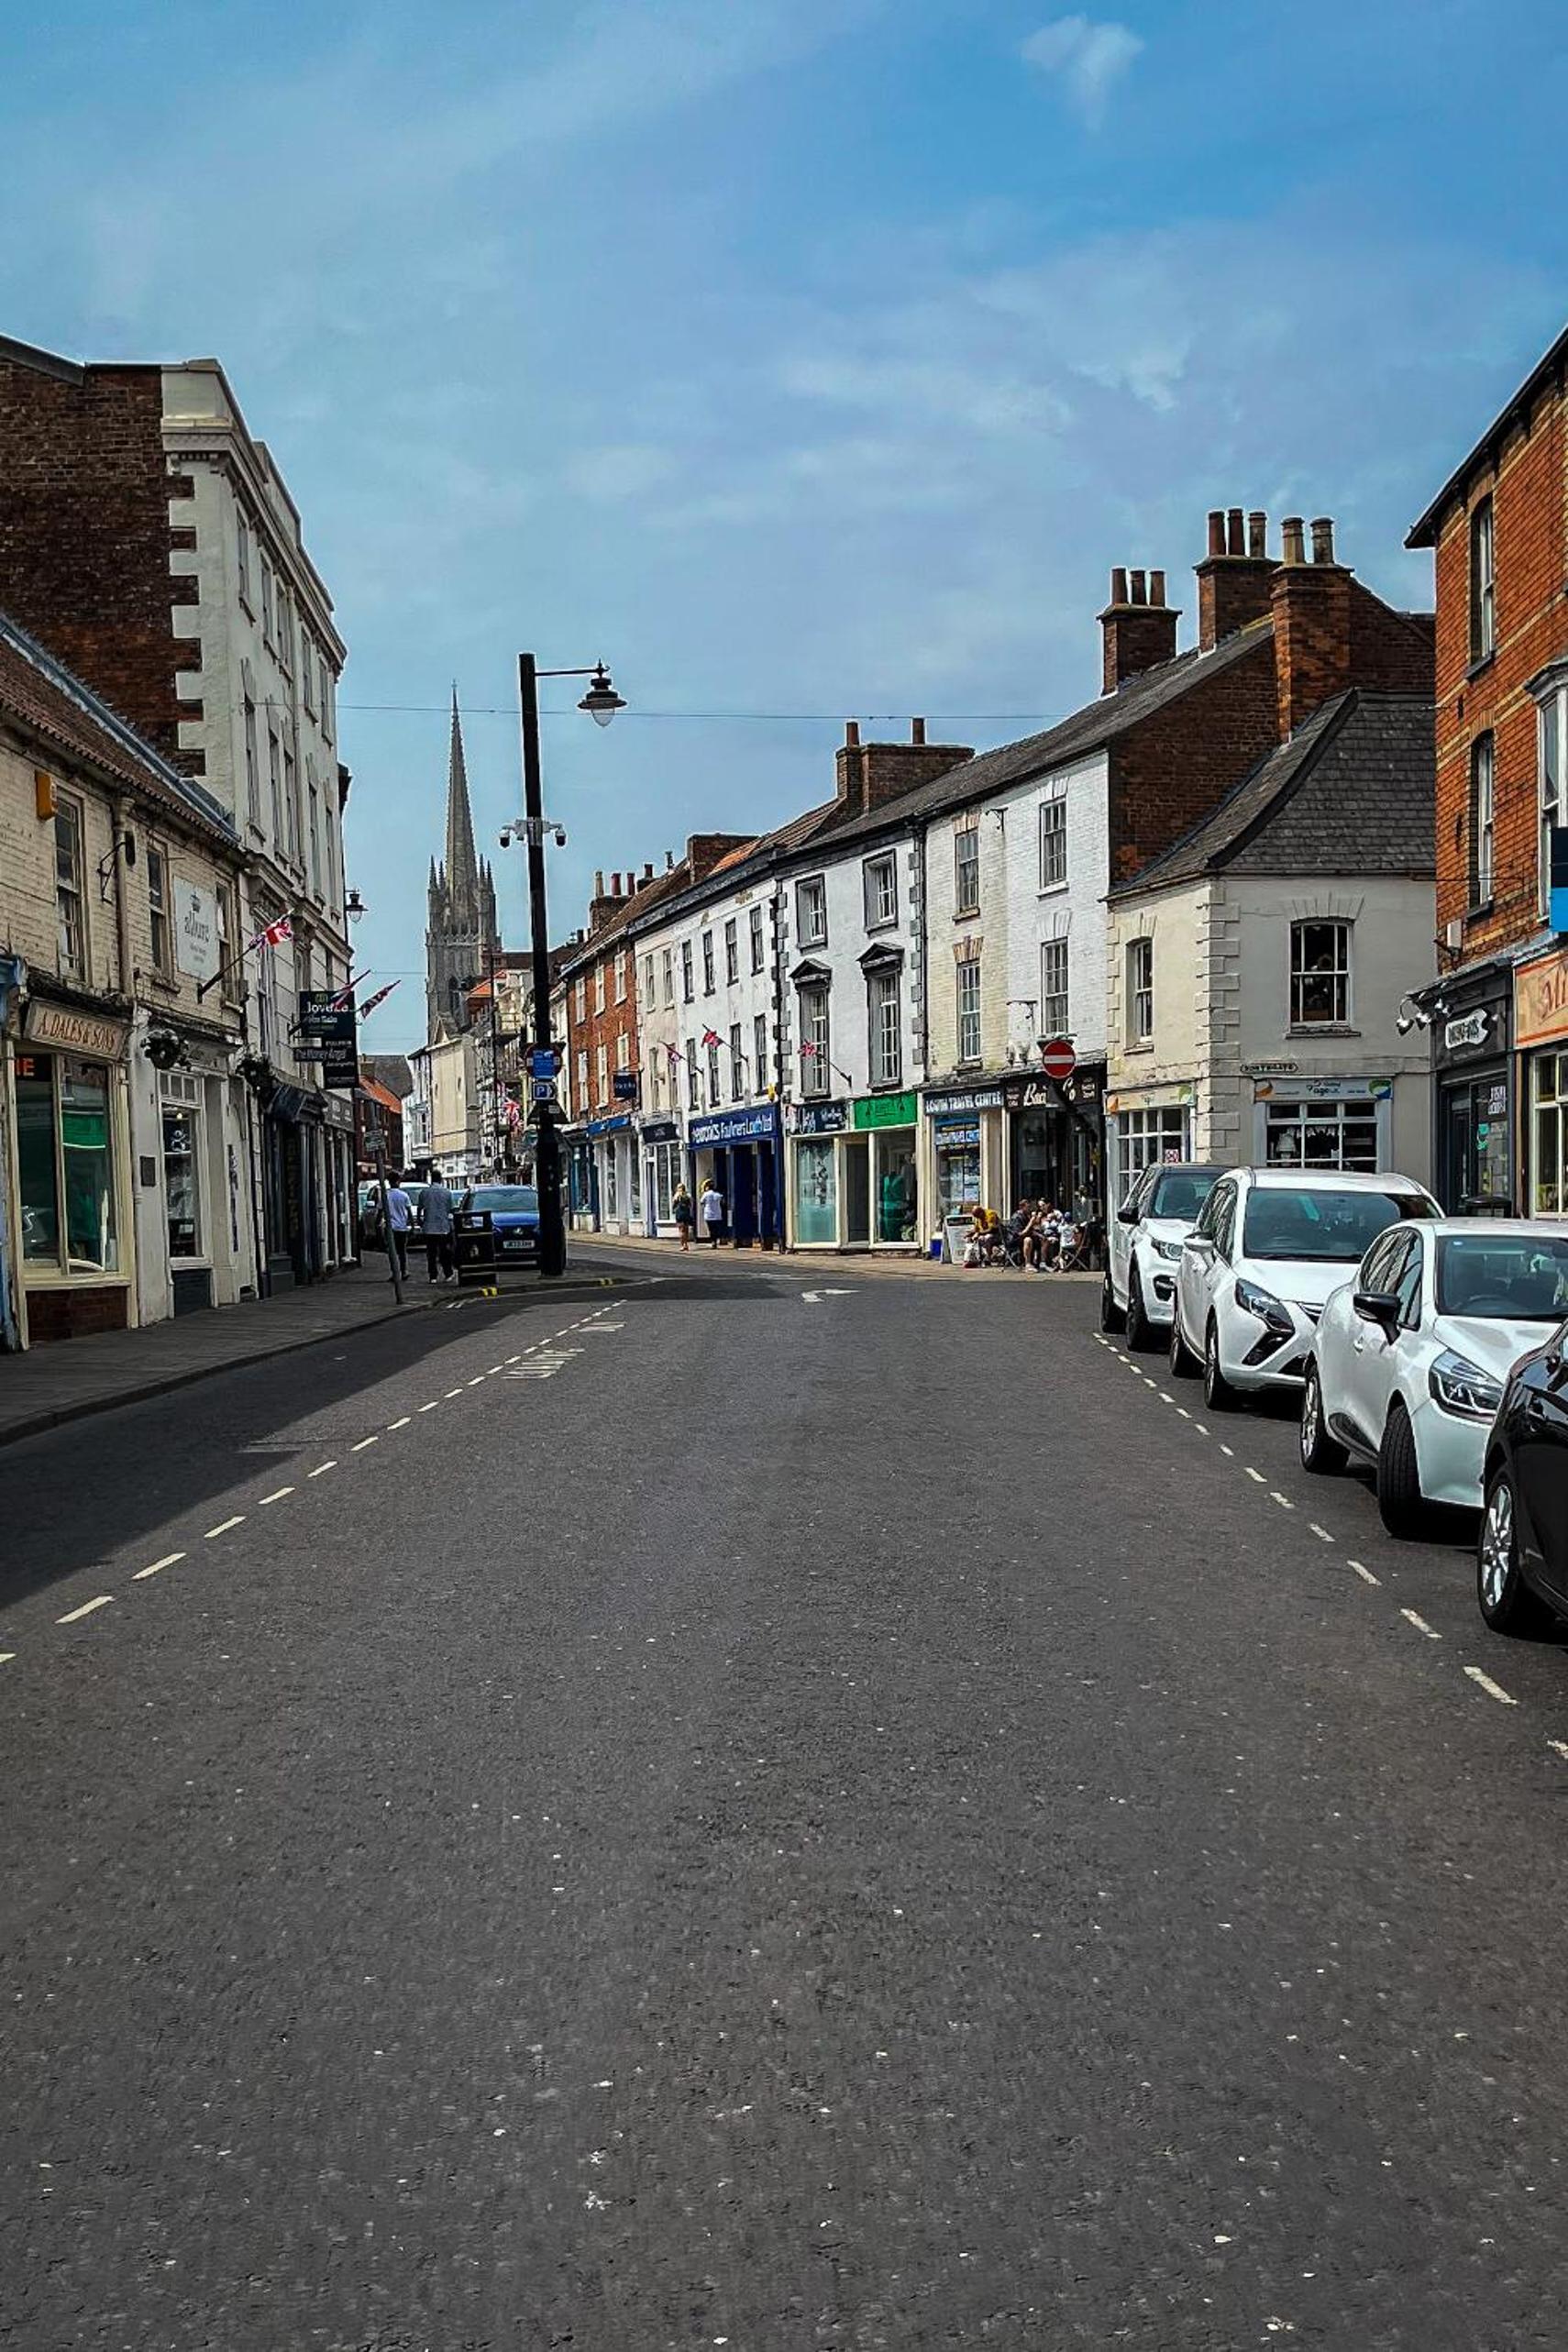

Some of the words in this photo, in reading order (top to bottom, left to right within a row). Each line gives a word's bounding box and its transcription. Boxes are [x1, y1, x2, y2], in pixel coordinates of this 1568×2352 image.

[50, 1012, 82, 1043] DALES
[91, 1025, 116, 1052] SONS
[925, 1098, 948, 1113] LOUTH
[948, 1094, 974, 1110] TRAVEL
[974, 1090, 1001, 1108] CENTRE
